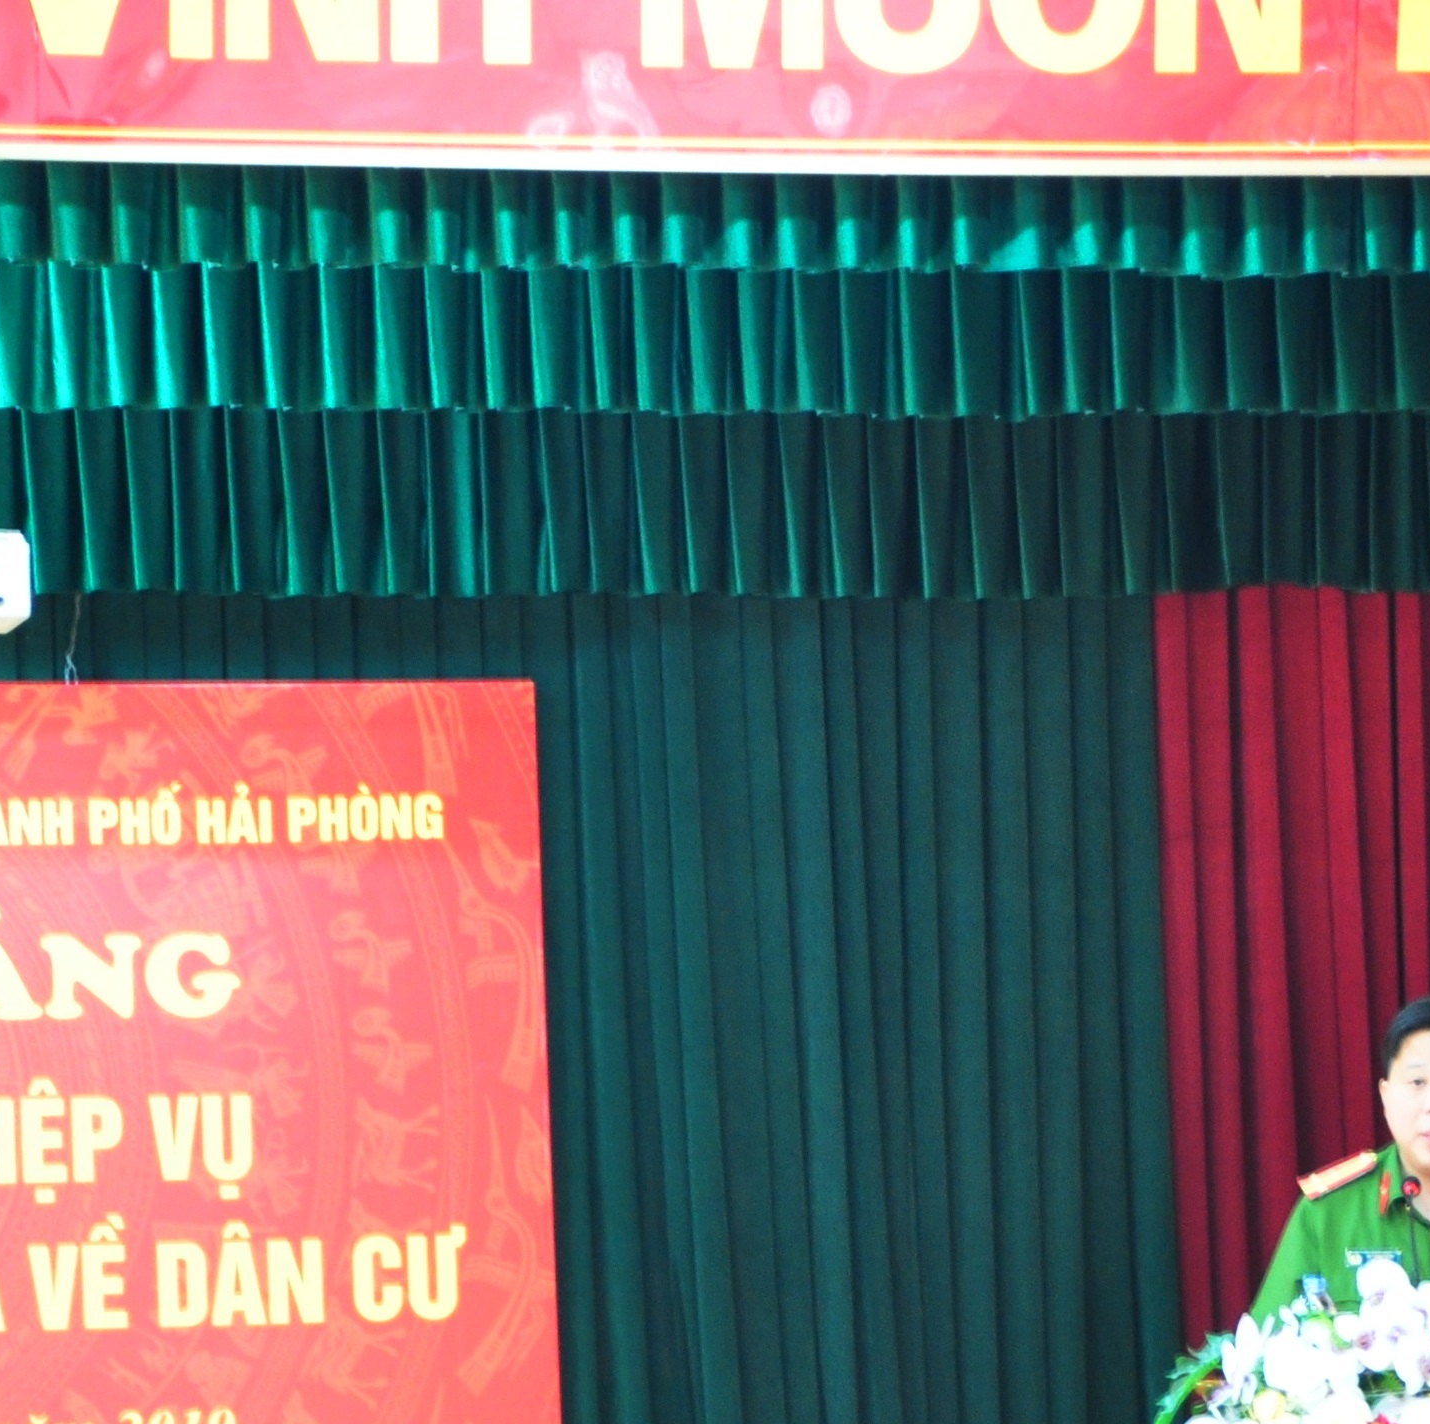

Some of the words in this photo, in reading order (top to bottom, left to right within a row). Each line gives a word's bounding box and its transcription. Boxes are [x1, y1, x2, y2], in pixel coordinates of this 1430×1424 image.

[88, 784, 181, 845] PHỐ
[196, 783, 272, 844] HẢI
[288, 785, 443, 842] PHÒNG
[149, 1093, 253, 1199] VỤ
[28, 1214, 128, 1330] VỀ
[157, 1222, 324, 1327] DÂN
[353, 1225, 466, 1321] CƯ
